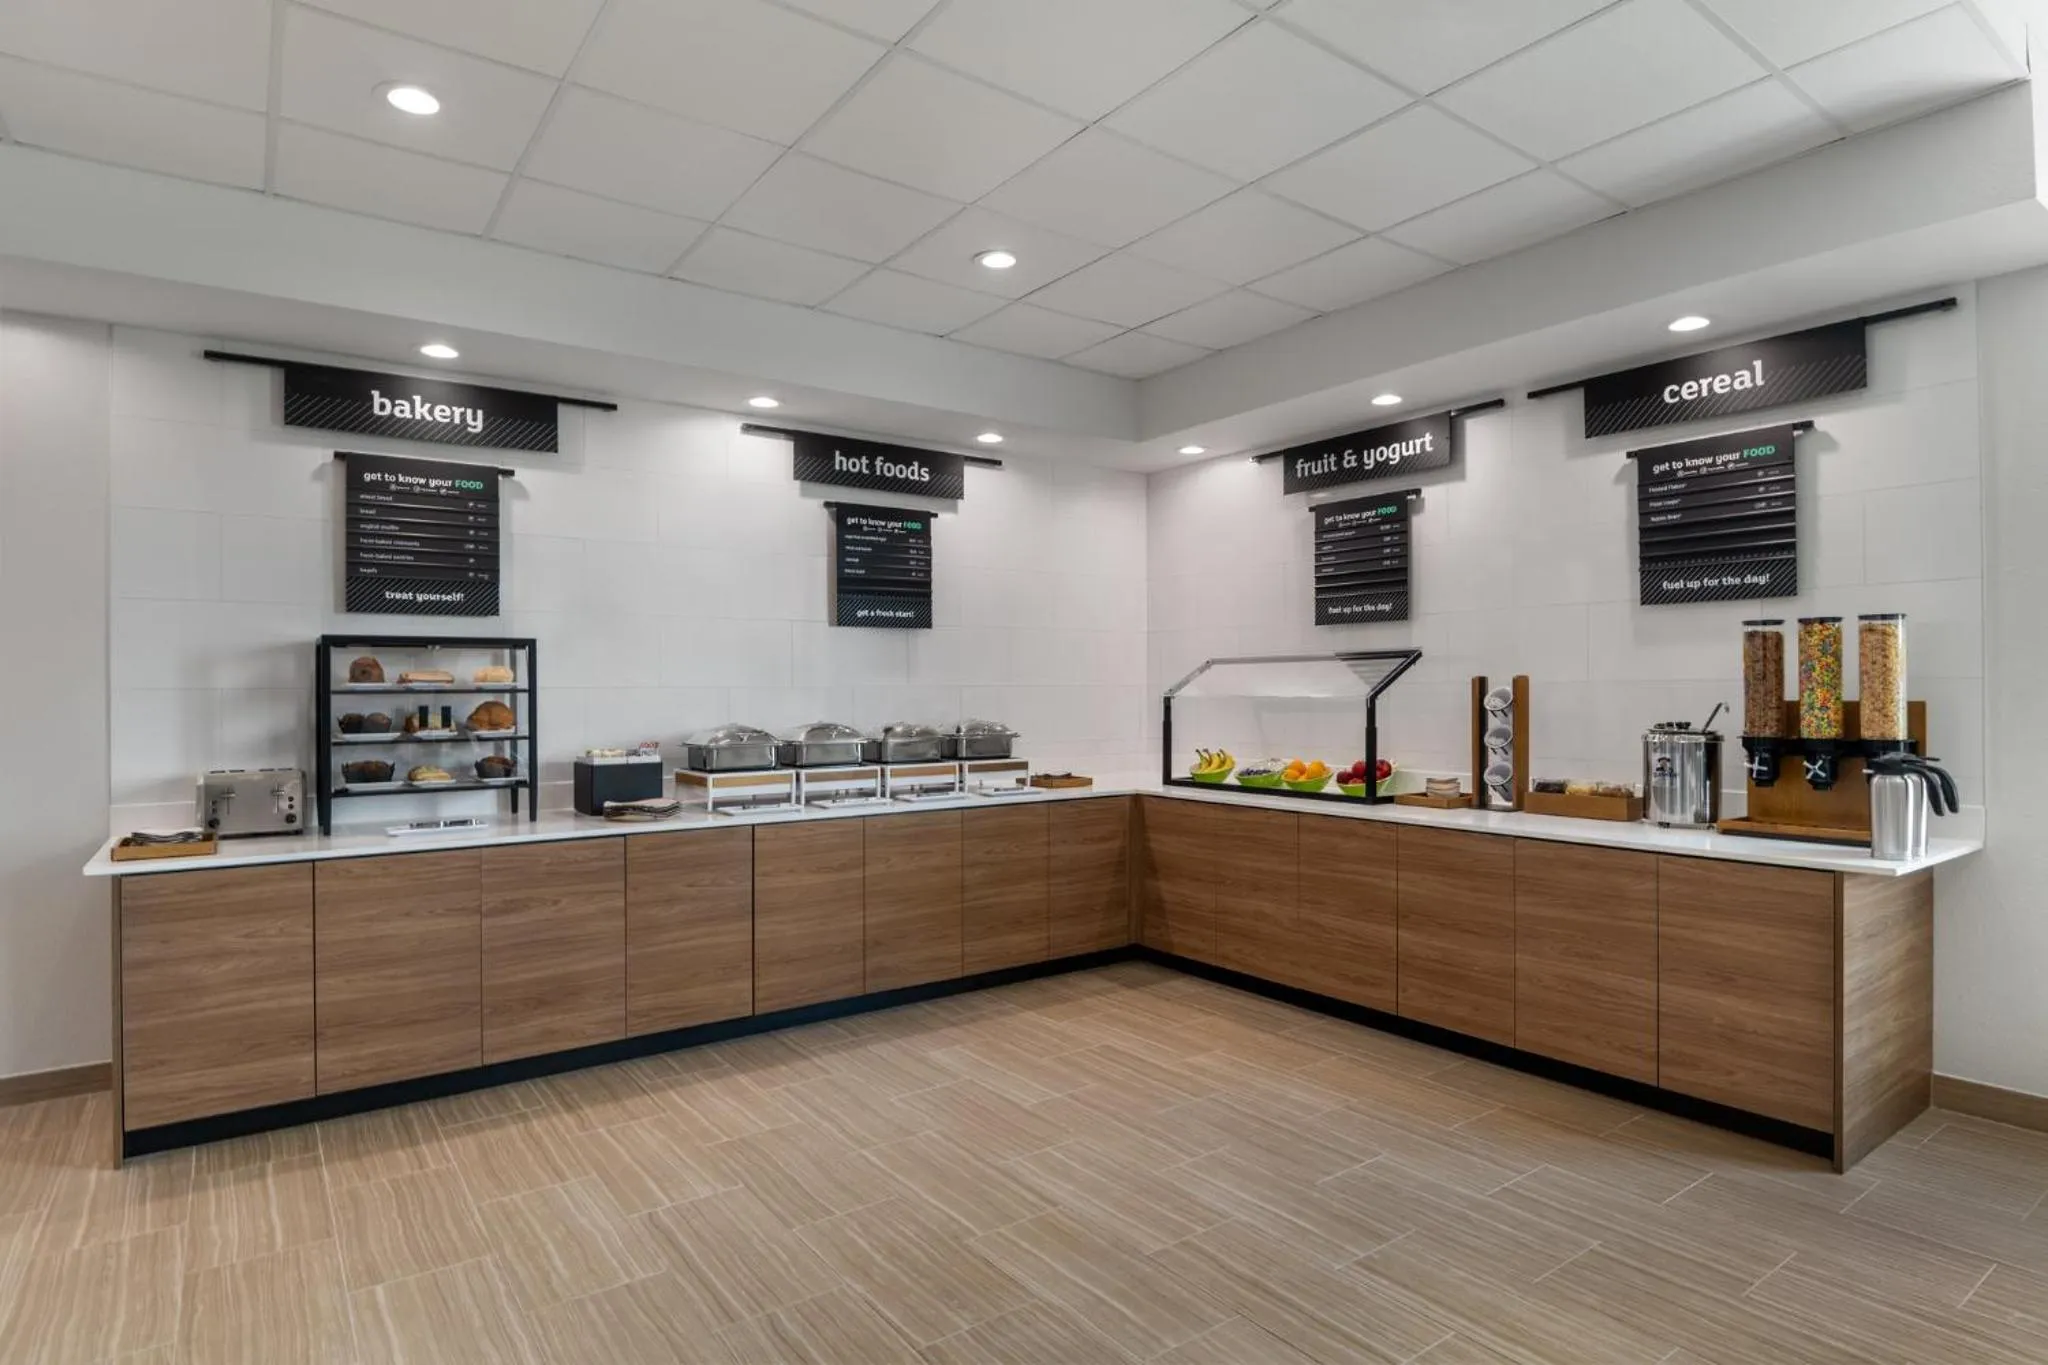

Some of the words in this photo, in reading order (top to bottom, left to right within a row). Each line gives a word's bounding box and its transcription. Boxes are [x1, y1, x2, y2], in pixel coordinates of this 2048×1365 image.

[1663, 359, 1765, 404] cereal
[371, 390, 484, 434] bakery
[834, 450, 870, 475] hot
[874, 456, 931, 483] foods
[1295, 455, 1338, 479] fruit
[1342, 450, 1357, 469] &
[1363, 432, 1434, 470] yogurt
[1652, 460, 1670, 475] get
[1672, 460, 1684, 470] to
[1685, 456, 1714, 467] know
[1715, 452, 1741, 466] your
[1743, 445, 1776, 459] FOOD
[363, 471, 382, 483] get
[384, 473, 396, 483] to
[398, 473, 426, 485] know
[429, 477, 453, 489] your
[455, 479, 484, 490] FOOD
[846, 517, 859, 526] get
[868, 517, 886, 526] know
[887, 520, 903, 529] your
[385, 591, 413, 600] treat
[416, 592, 465, 602] yourself!
[1662, 579, 1684, 590] fuel
[1687, 580, 1701, 590] up
[1703, 577, 1721, 587] for
[1722, 574, 1742, 585] the
[1743, 573, 1770, 586] day!
